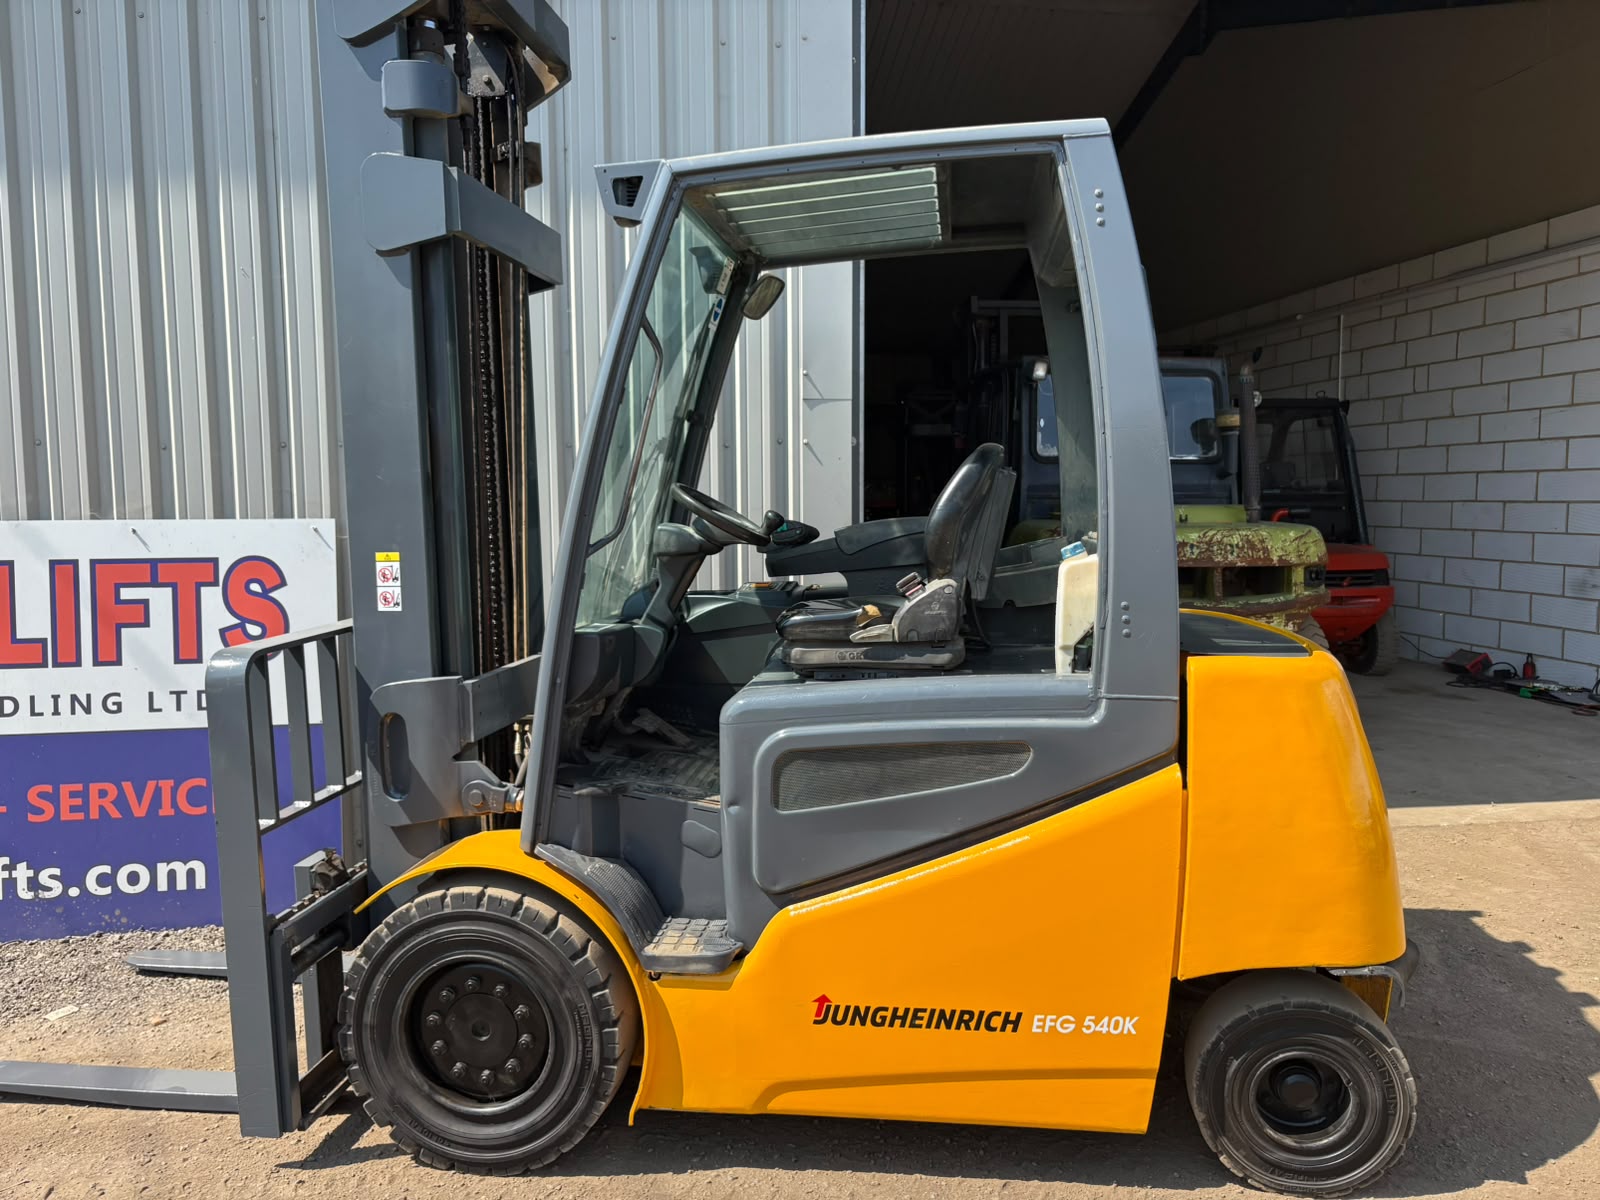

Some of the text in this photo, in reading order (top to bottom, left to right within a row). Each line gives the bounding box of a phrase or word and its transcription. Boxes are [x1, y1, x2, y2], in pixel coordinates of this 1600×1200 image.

[27, 777, 215, 823] SERVIC
[813, 1002, 1139, 1035] JUNGHEINRICH EFG 540K
